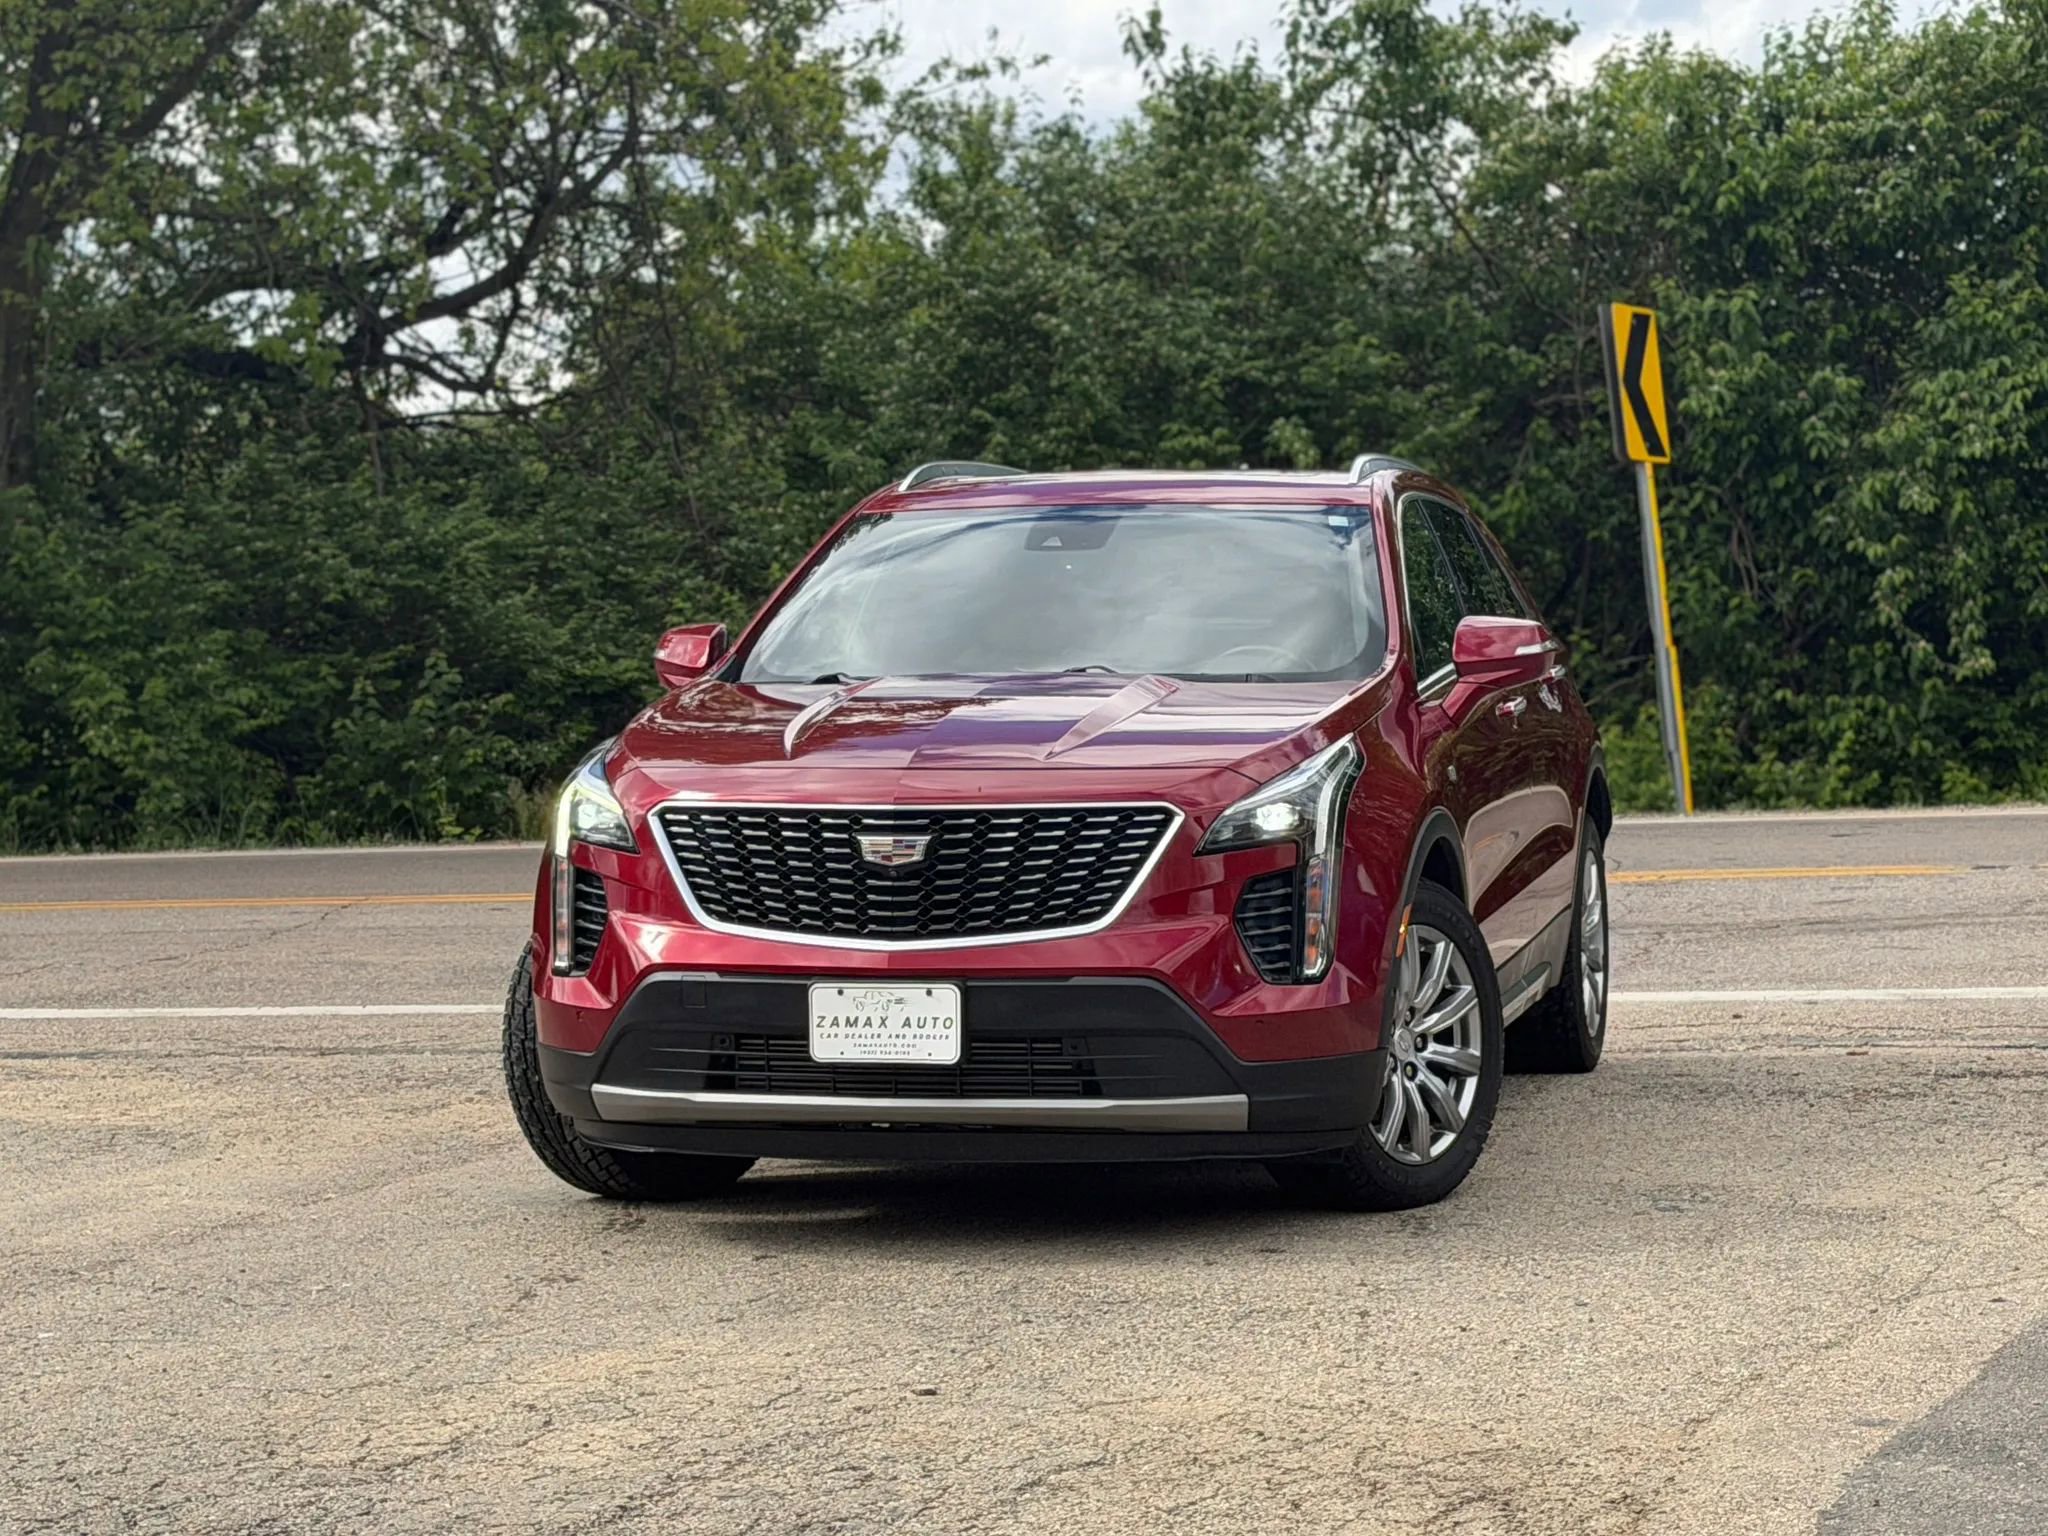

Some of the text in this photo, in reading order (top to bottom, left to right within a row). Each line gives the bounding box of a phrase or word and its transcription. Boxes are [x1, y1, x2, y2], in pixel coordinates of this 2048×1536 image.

[816, 1015, 954, 1030] ZAMAX AUTO
[844, 1032, 882, 1040] DEALER
[912, 1033, 950, 1041] BROKER
